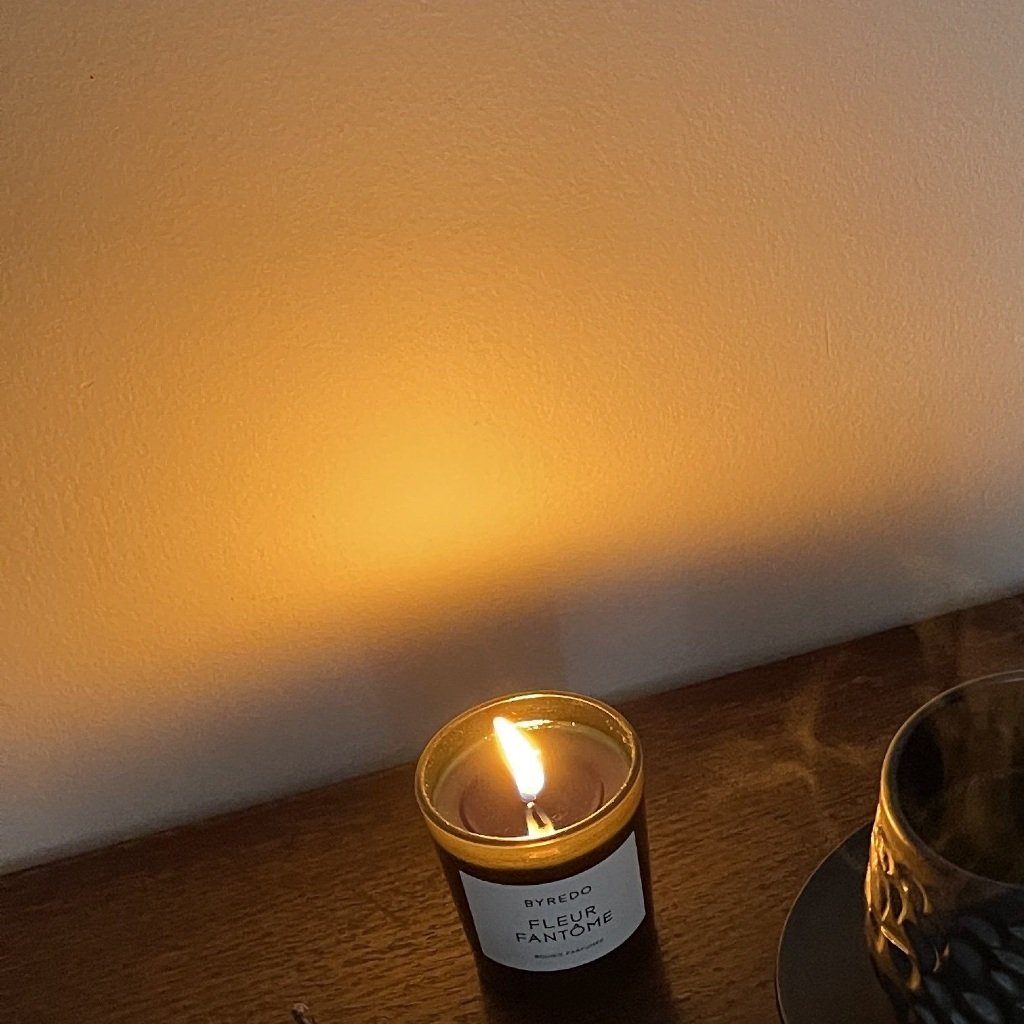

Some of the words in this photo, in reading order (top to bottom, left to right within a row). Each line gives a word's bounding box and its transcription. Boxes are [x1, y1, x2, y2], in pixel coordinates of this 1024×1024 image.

[524, 885, 593, 908] BYREDO
[515, 910, 614, 944] FANTÔME
[528, 905, 597, 930] FLEUR
